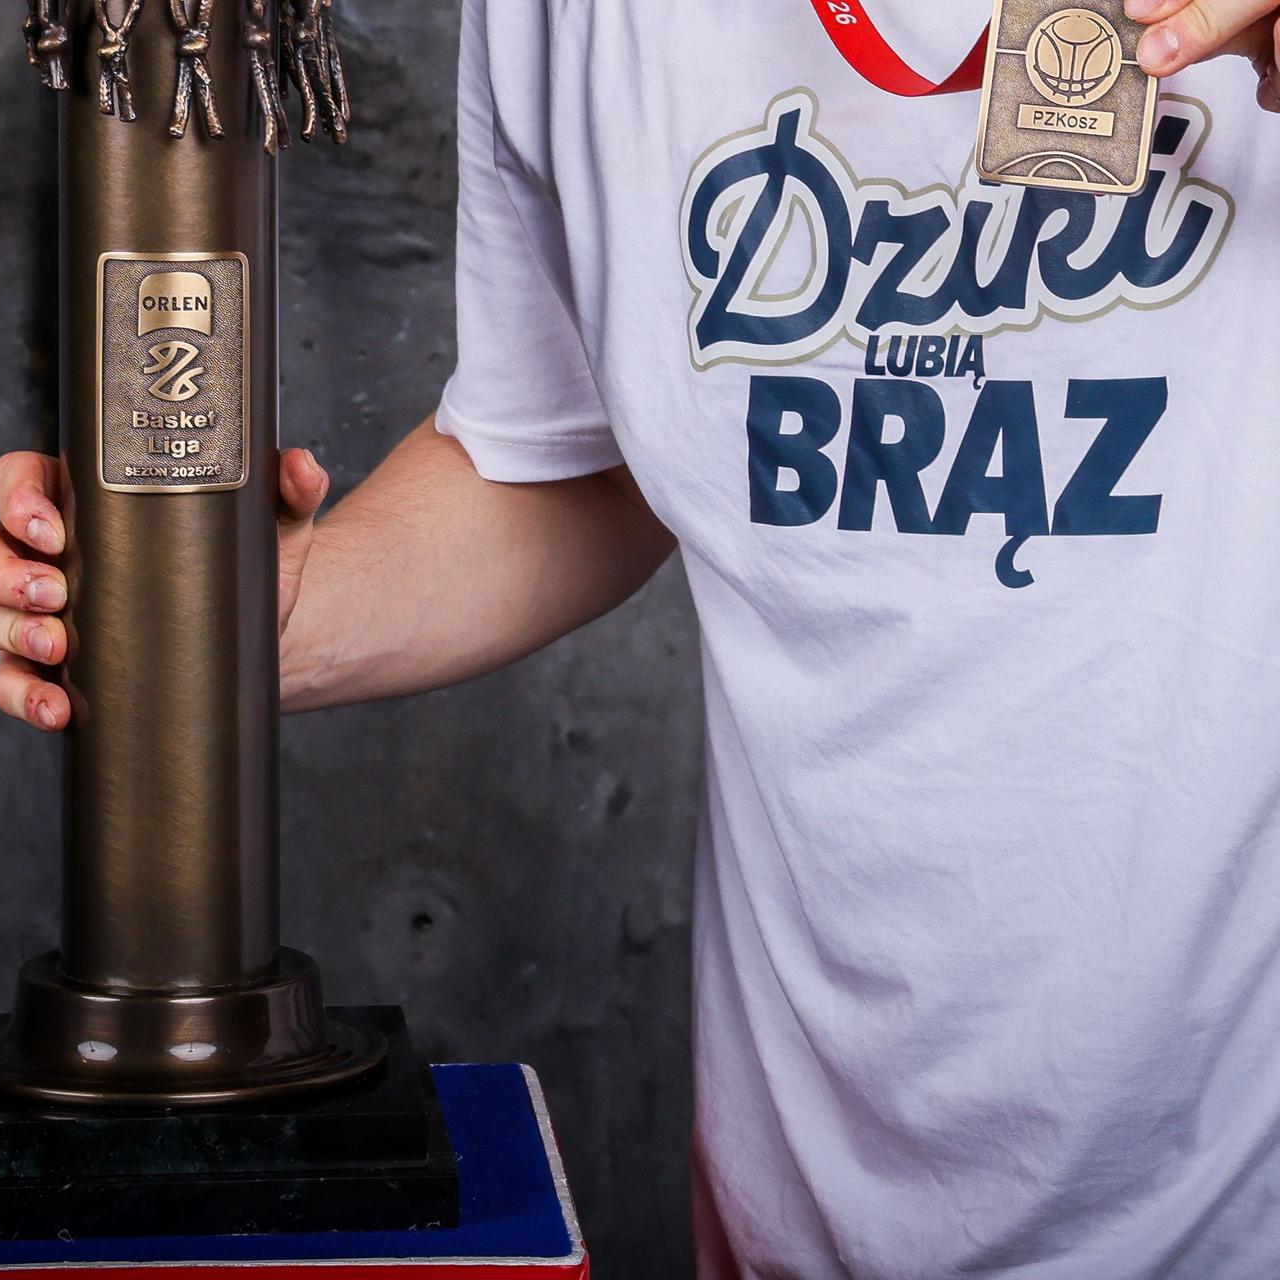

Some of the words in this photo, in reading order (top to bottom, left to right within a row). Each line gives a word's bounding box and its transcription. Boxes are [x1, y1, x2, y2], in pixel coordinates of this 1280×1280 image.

[142, 296, 208, 312] ORLEN
[864, 334, 986, 391] LUBIĄ
[132, 410, 216, 430] Basket
[148, 435, 201, 459] Liga
[124, 466, 168, 477] SEZON
[171, 465, 222, 478] 2025/26
[746, 375, 1169, 589] BRĄZ
